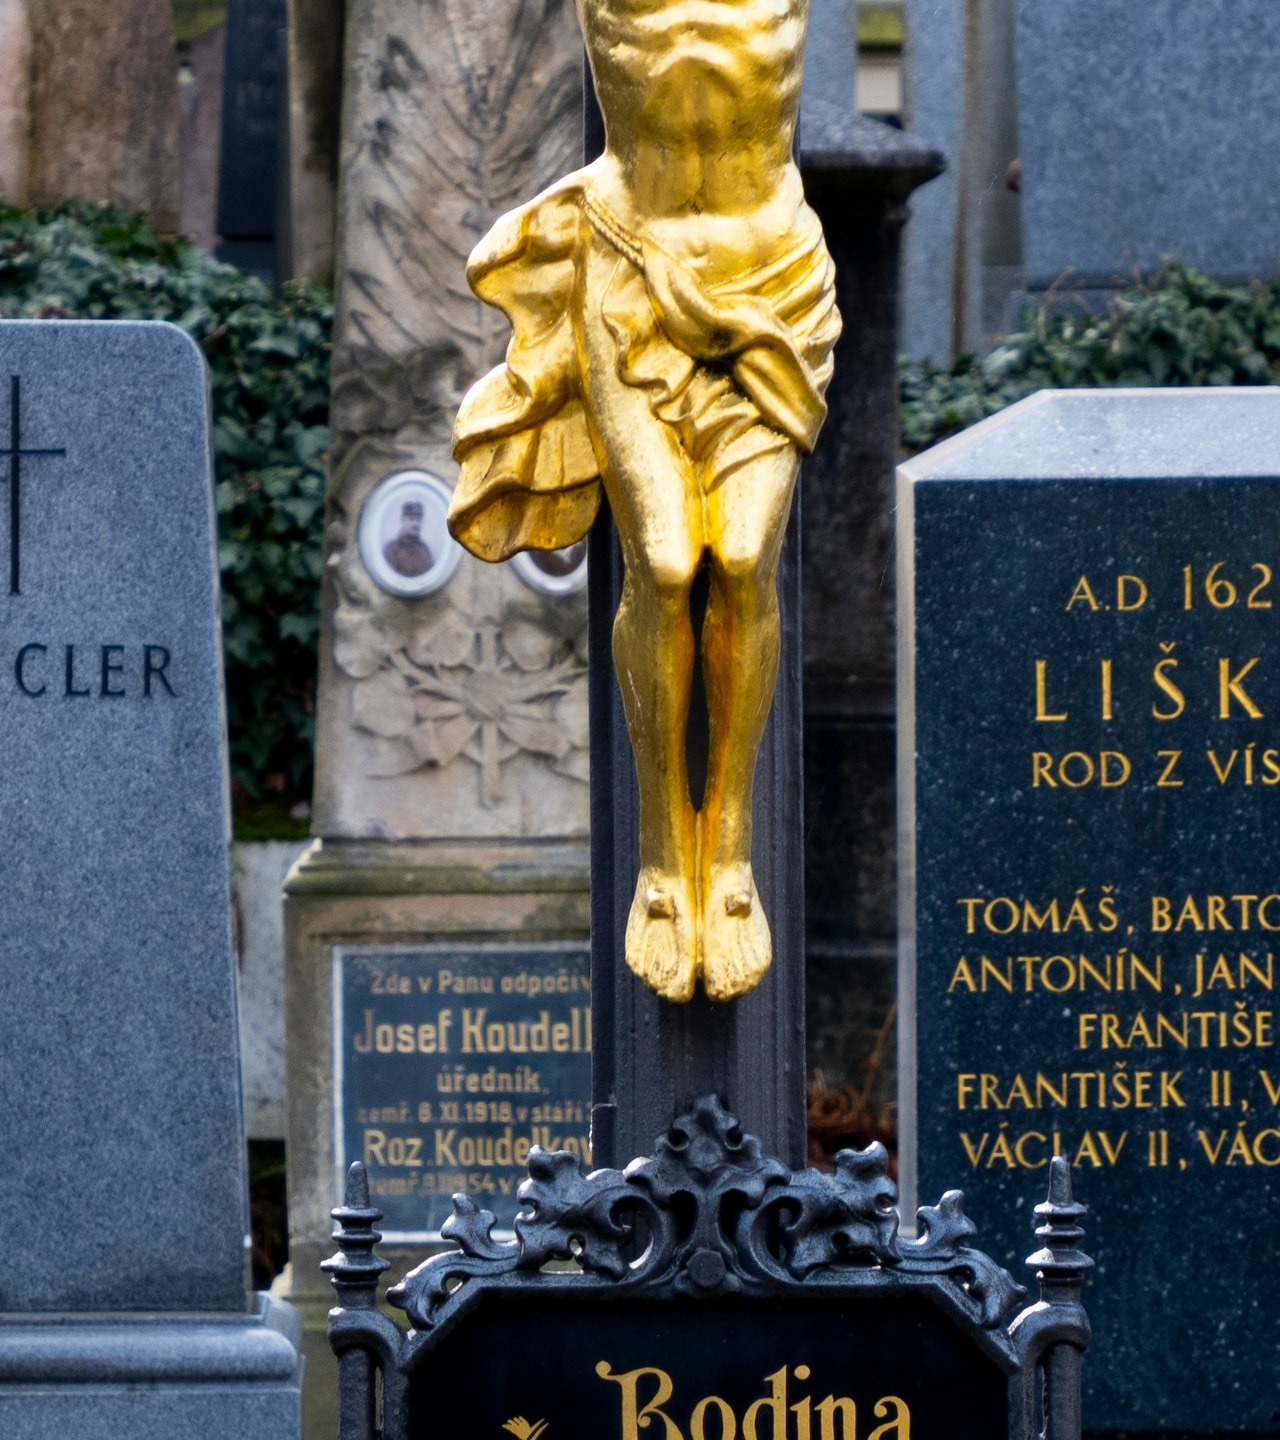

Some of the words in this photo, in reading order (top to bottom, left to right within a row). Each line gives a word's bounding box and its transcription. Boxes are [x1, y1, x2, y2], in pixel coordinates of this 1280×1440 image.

[1031, 750, 1132, 788] ROD
[1156, 749, 1185, 788] Z
[956, 885, 1135, 935] TOMÁŠ,
[370, 970, 411, 995] Zde
[417, 977, 432, 994] v
[947, 947, 1183, 996] ANTONÍN,
[353, 1009, 453, 1054] Josef
[956, 1062, 1186, 1110] FRANTIŠEK
[595, 1360, 911, 1440] Rodina
